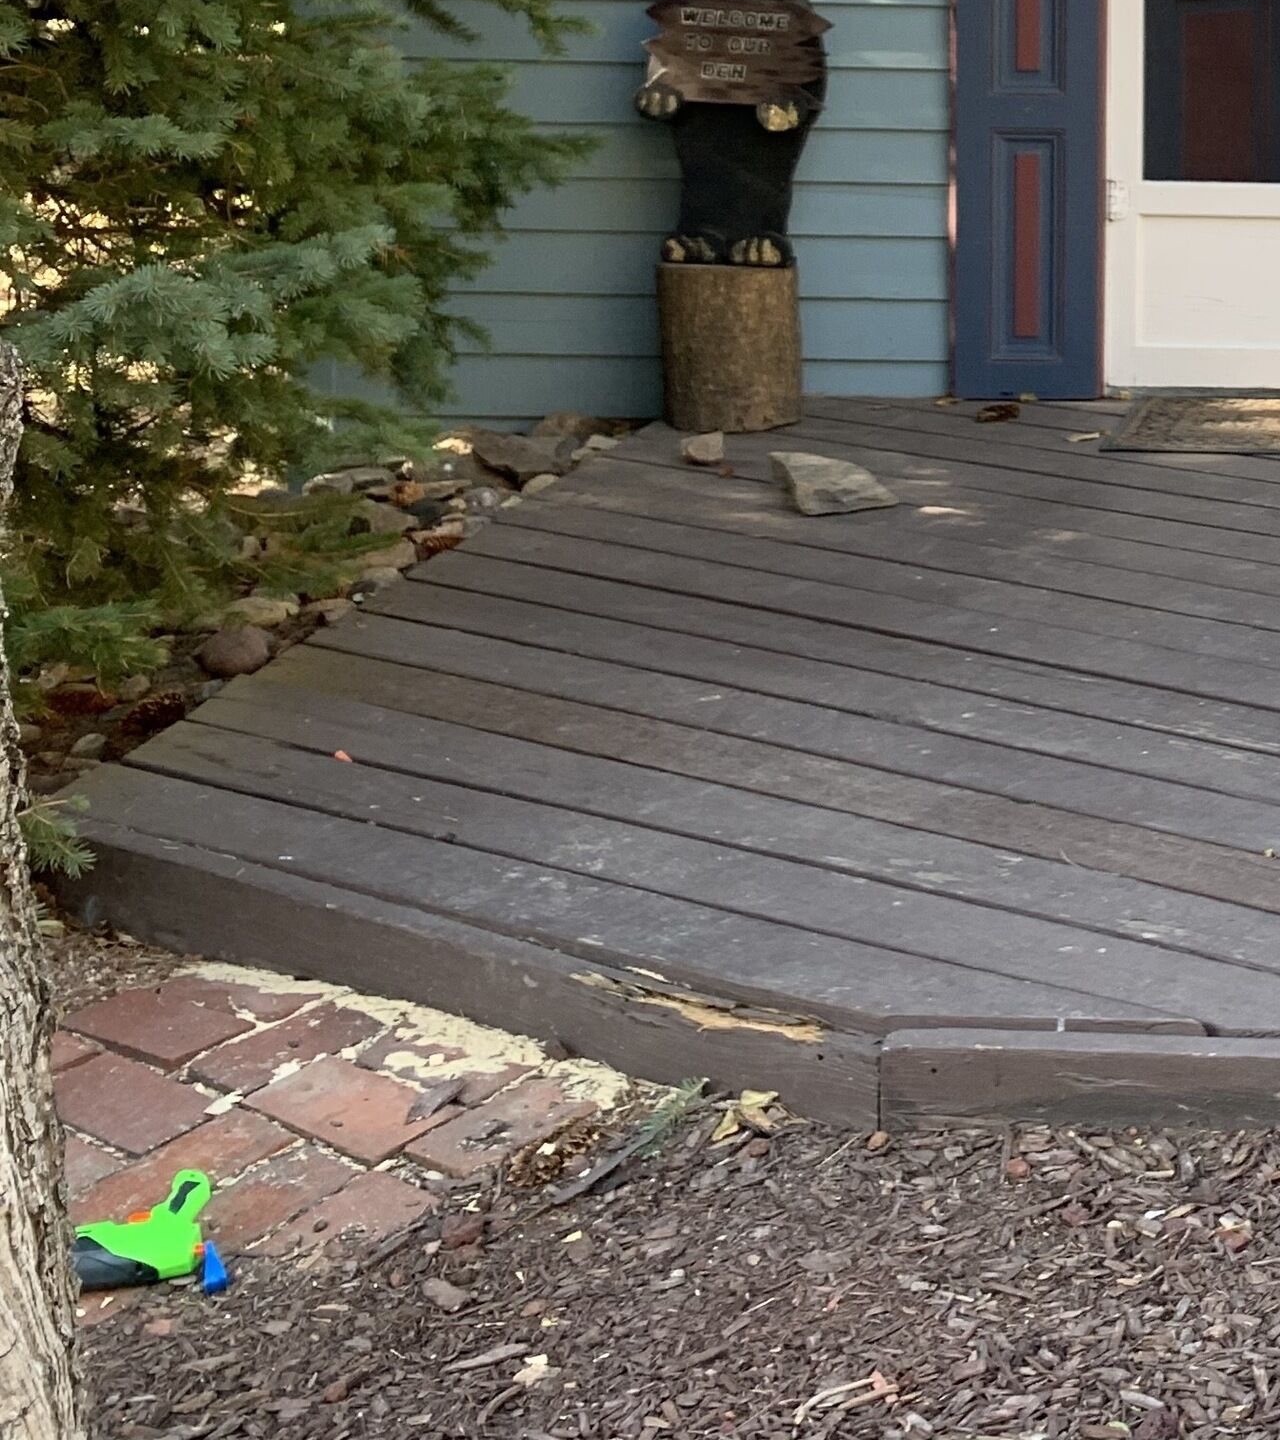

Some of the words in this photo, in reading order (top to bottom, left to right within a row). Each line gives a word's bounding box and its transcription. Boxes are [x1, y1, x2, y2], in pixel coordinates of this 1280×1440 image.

[681, 7, 790, 31] WELCOME
[685, 34, 713, 51] TO
[728, 37, 771, 55] OUR
[701, 62, 746, 81] DEN
